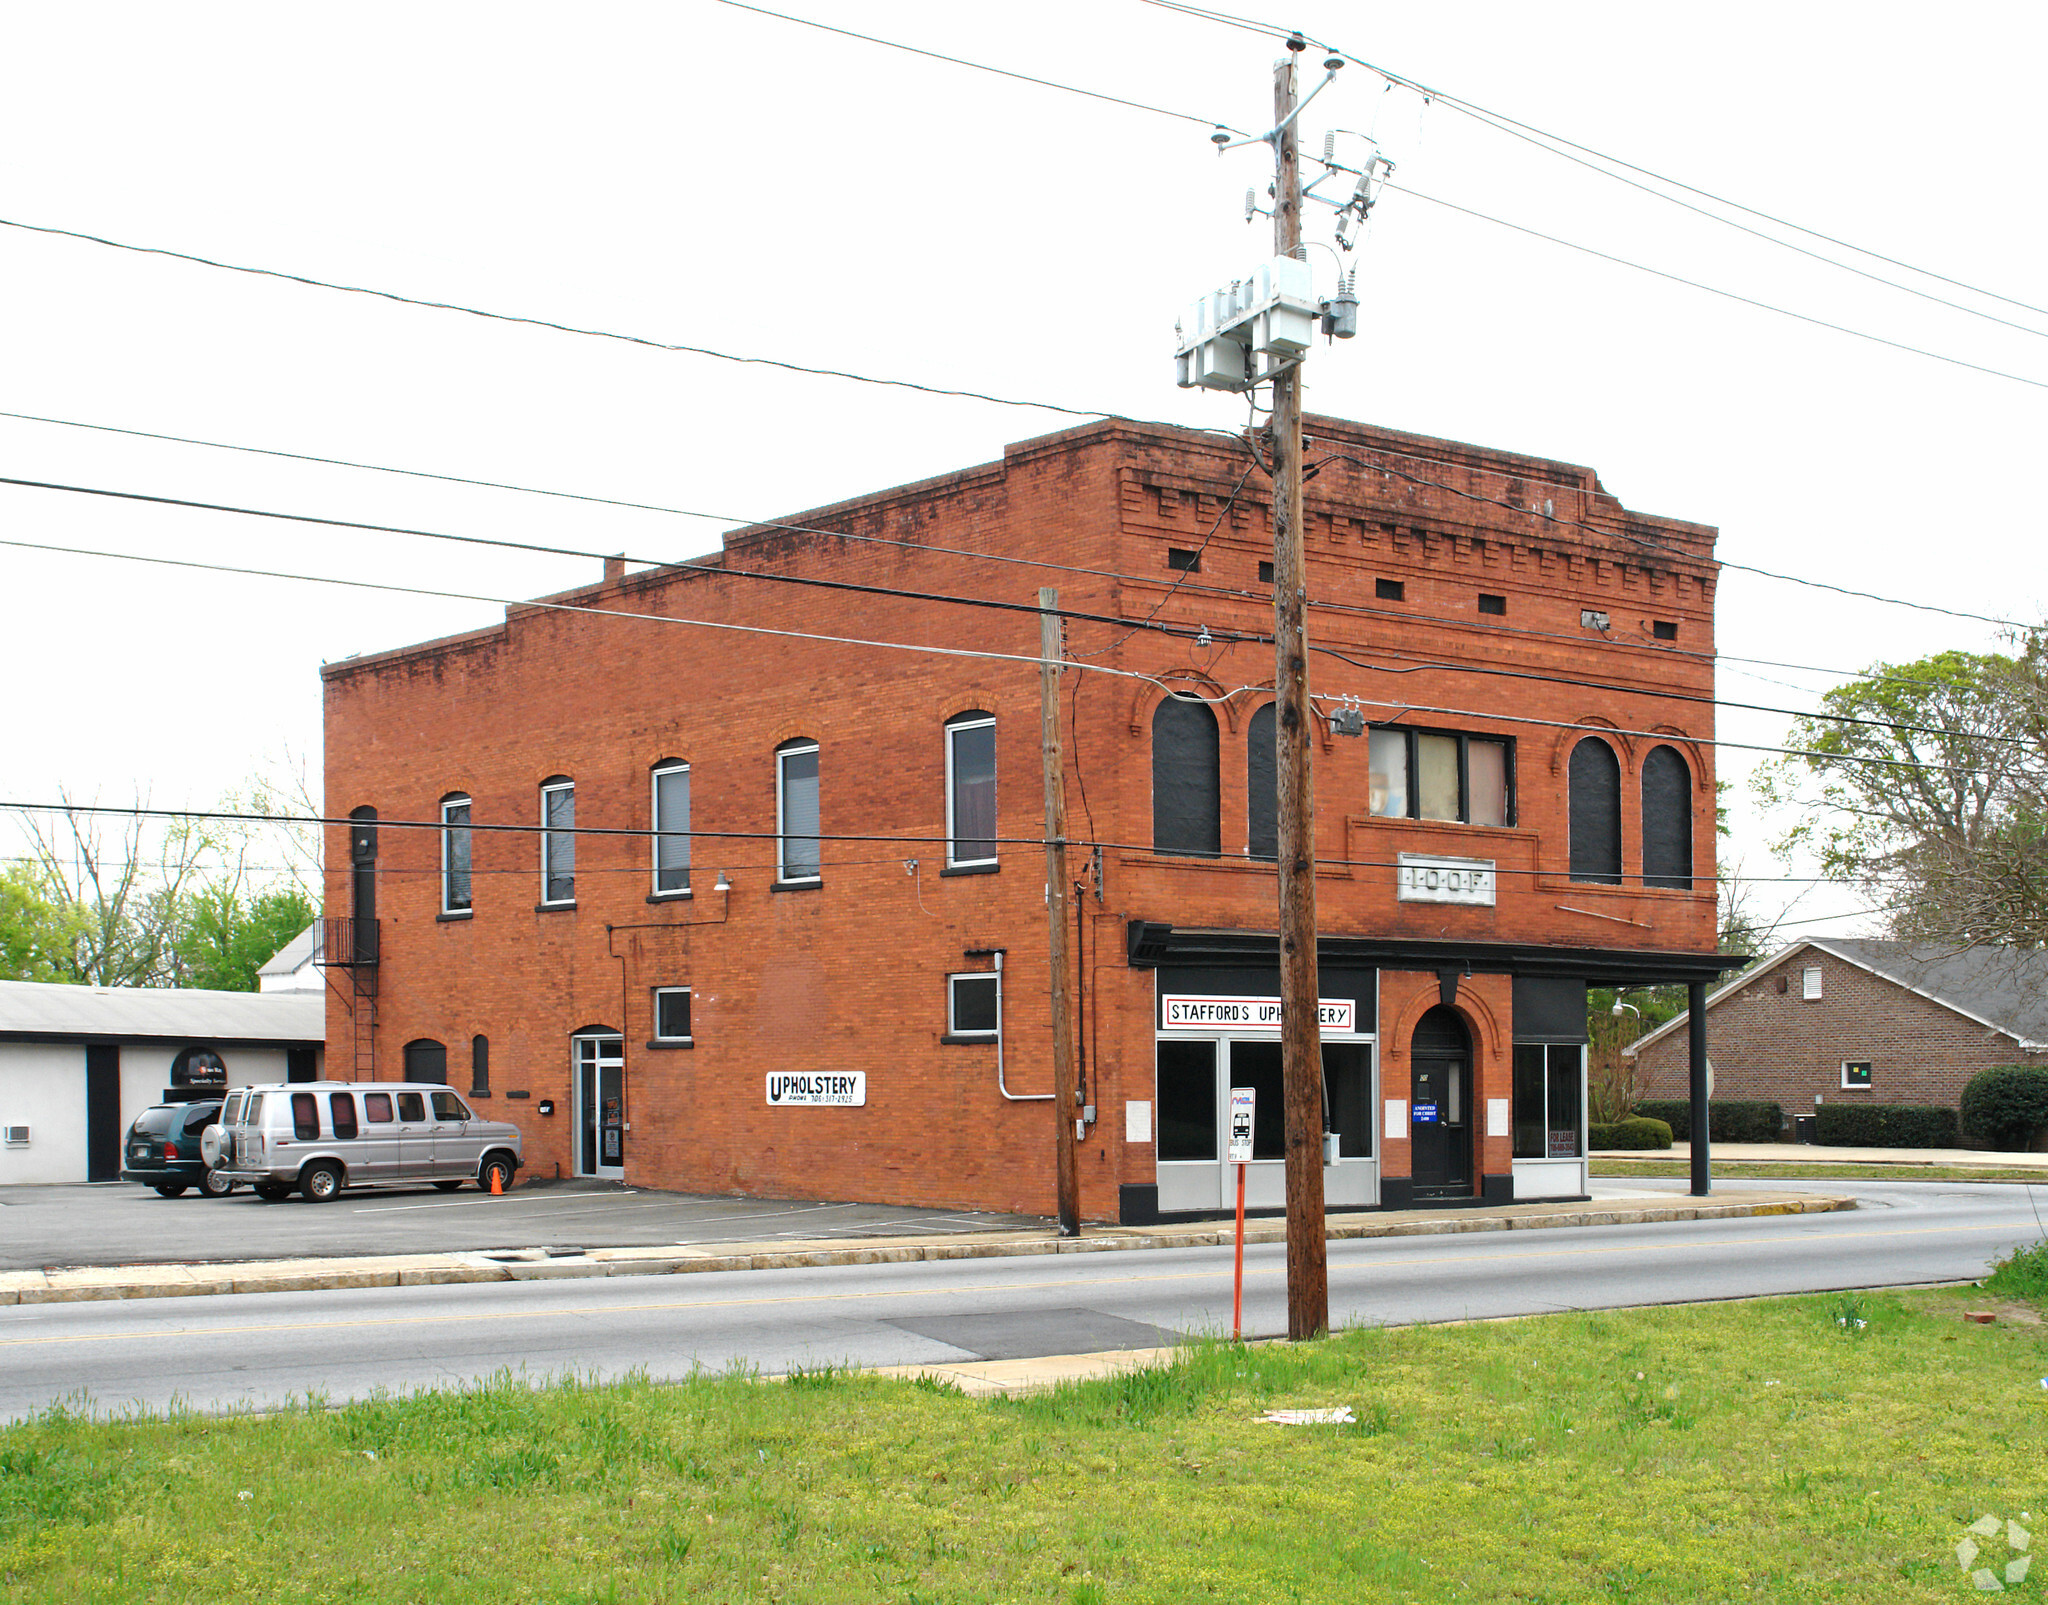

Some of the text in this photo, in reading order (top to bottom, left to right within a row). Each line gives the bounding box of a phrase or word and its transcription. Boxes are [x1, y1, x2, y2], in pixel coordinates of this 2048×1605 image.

[1259, 1006, 1347, 1023] UPHERY
[770, 1076, 857, 1102] UPHOLSTERY
[1229, 1139, 1252, 1147] BUS STOP
[1550, 1132, 1574, 1142] FOR LEASE
